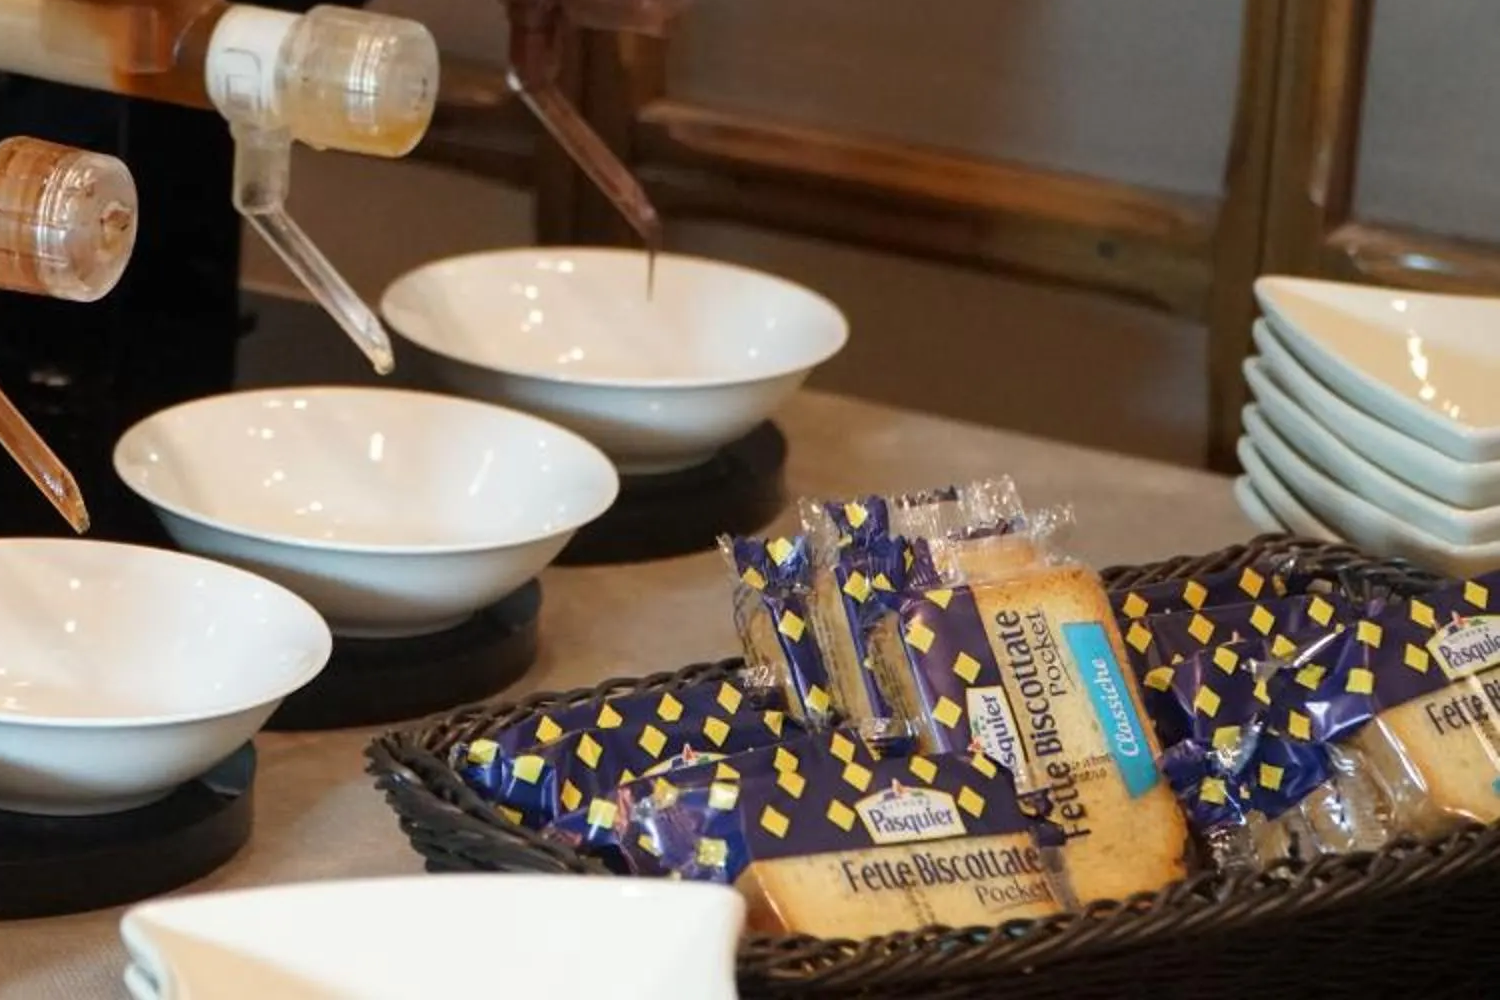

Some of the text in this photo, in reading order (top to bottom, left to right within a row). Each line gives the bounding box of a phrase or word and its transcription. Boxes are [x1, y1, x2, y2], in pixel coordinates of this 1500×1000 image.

[995, 609, 1064, 758] Biscottate
[867, 806, 955, 836] Pasquier
[1046, 760, 1092, 840] Fette
[841, 844, 1048, 894] Fette Biscottate
[975, 879, 1057, 906] Pocket
